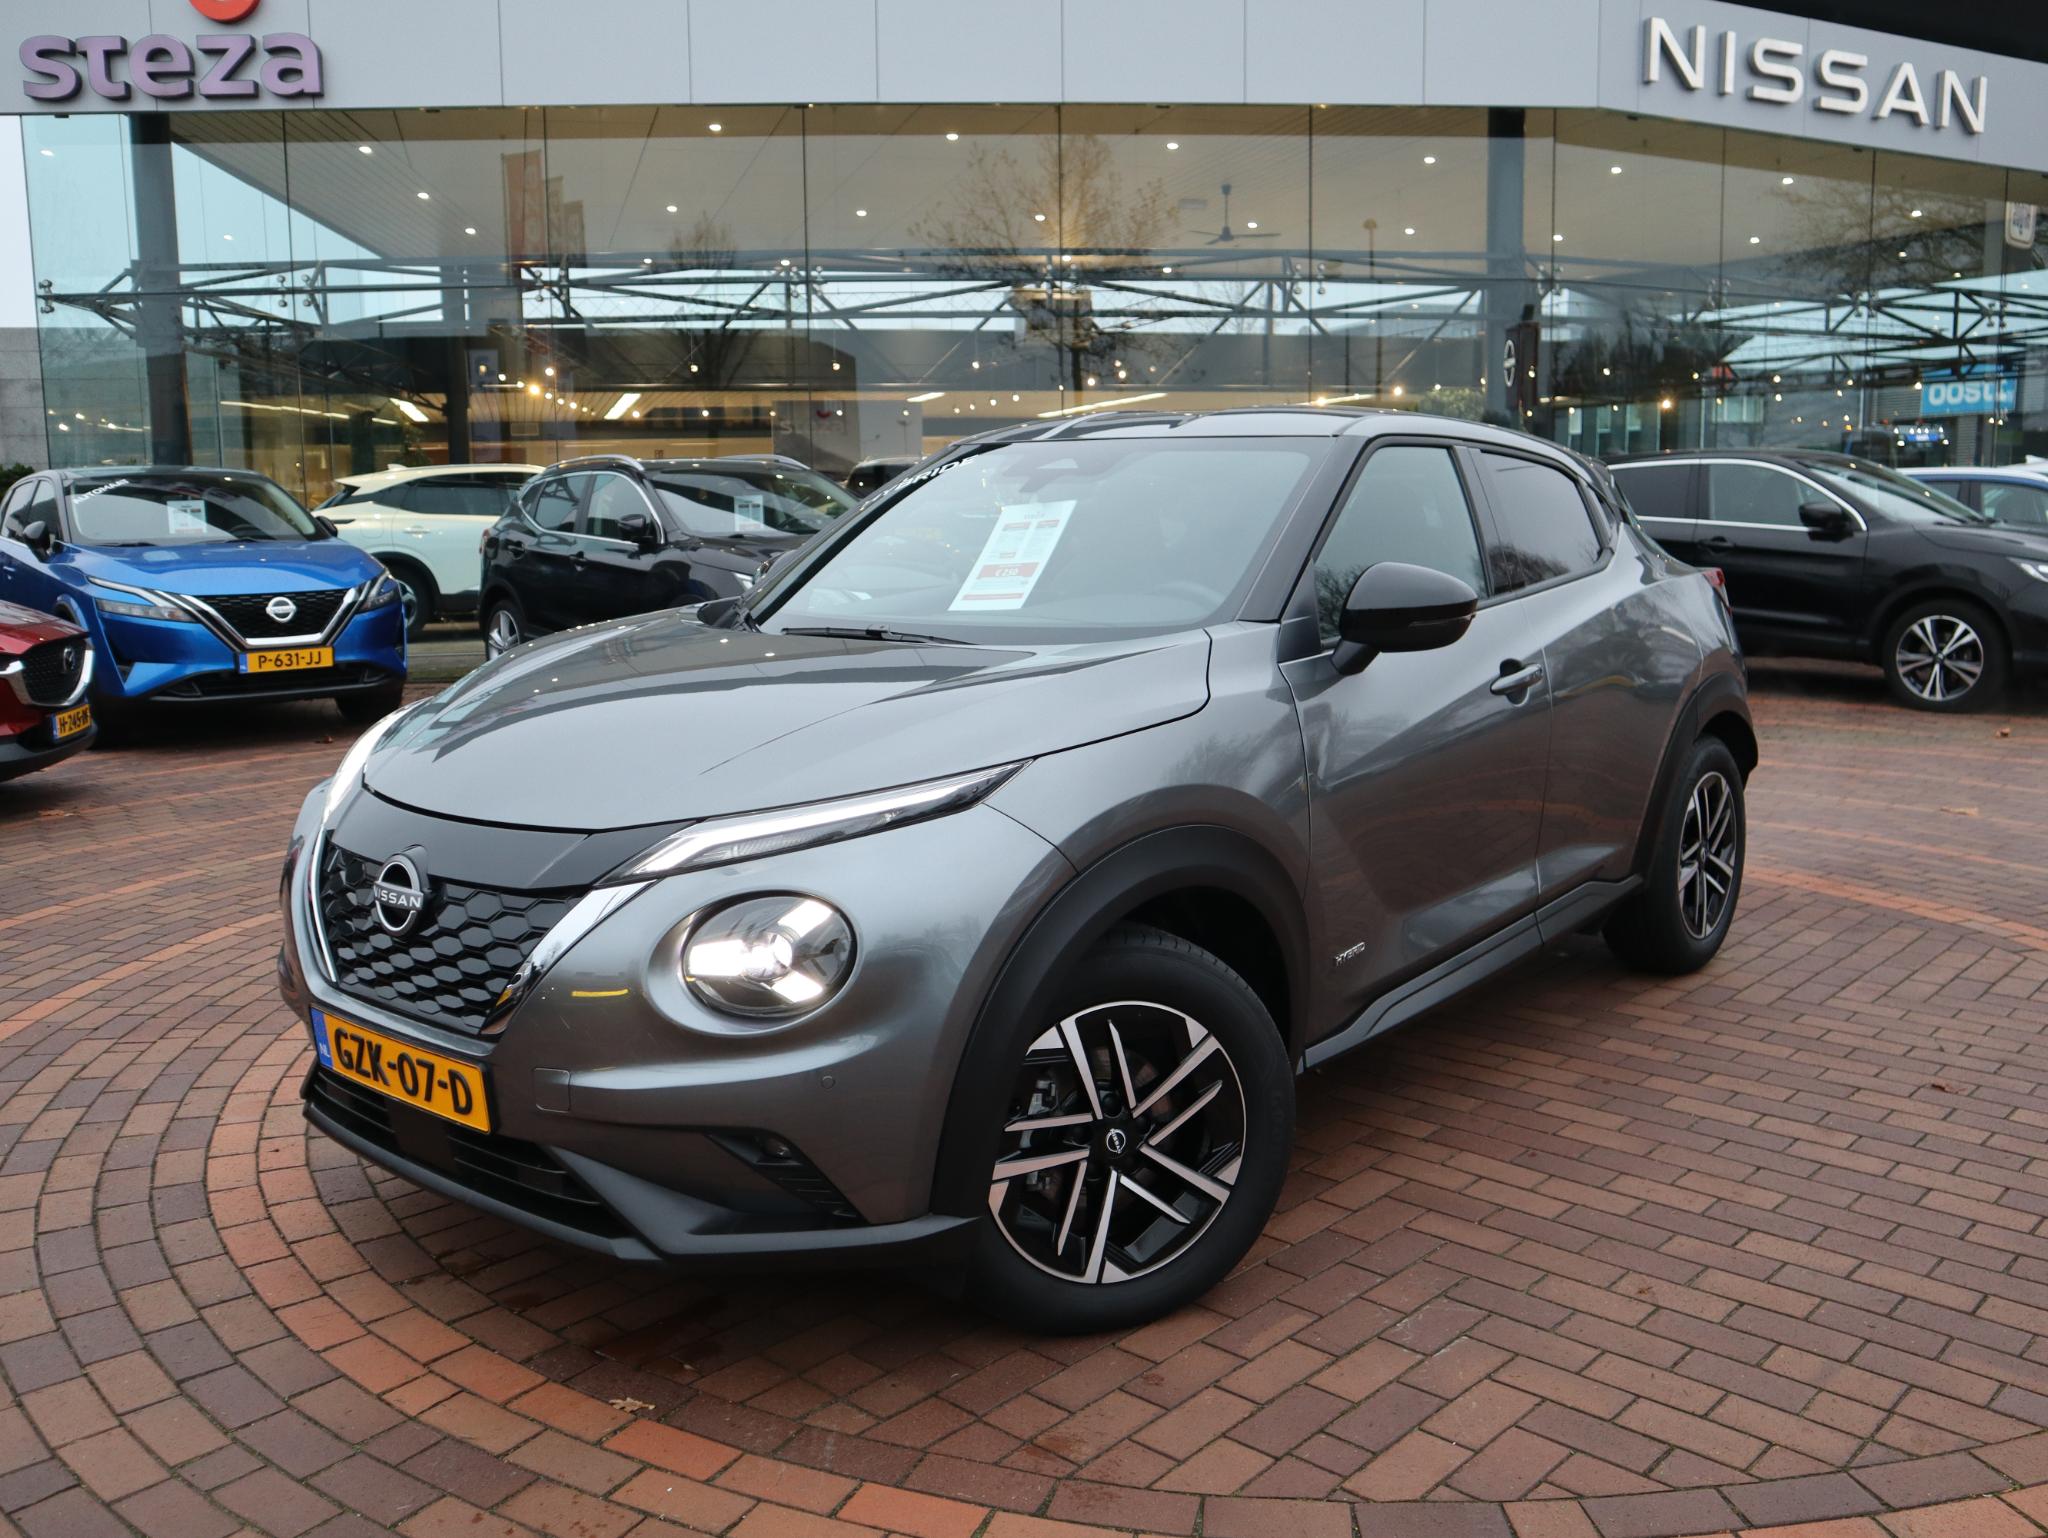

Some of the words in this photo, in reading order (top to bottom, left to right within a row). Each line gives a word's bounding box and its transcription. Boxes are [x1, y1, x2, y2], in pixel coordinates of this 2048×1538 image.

[18, 32, 325, 101] steza
[1643, 16, 1988, 135] NISSAN
[258, 651, 322, 669] P-631-JJ
[319, 1043, 330, 1058] NL
[334, 1026, 473, 1115] GZK-07-D
